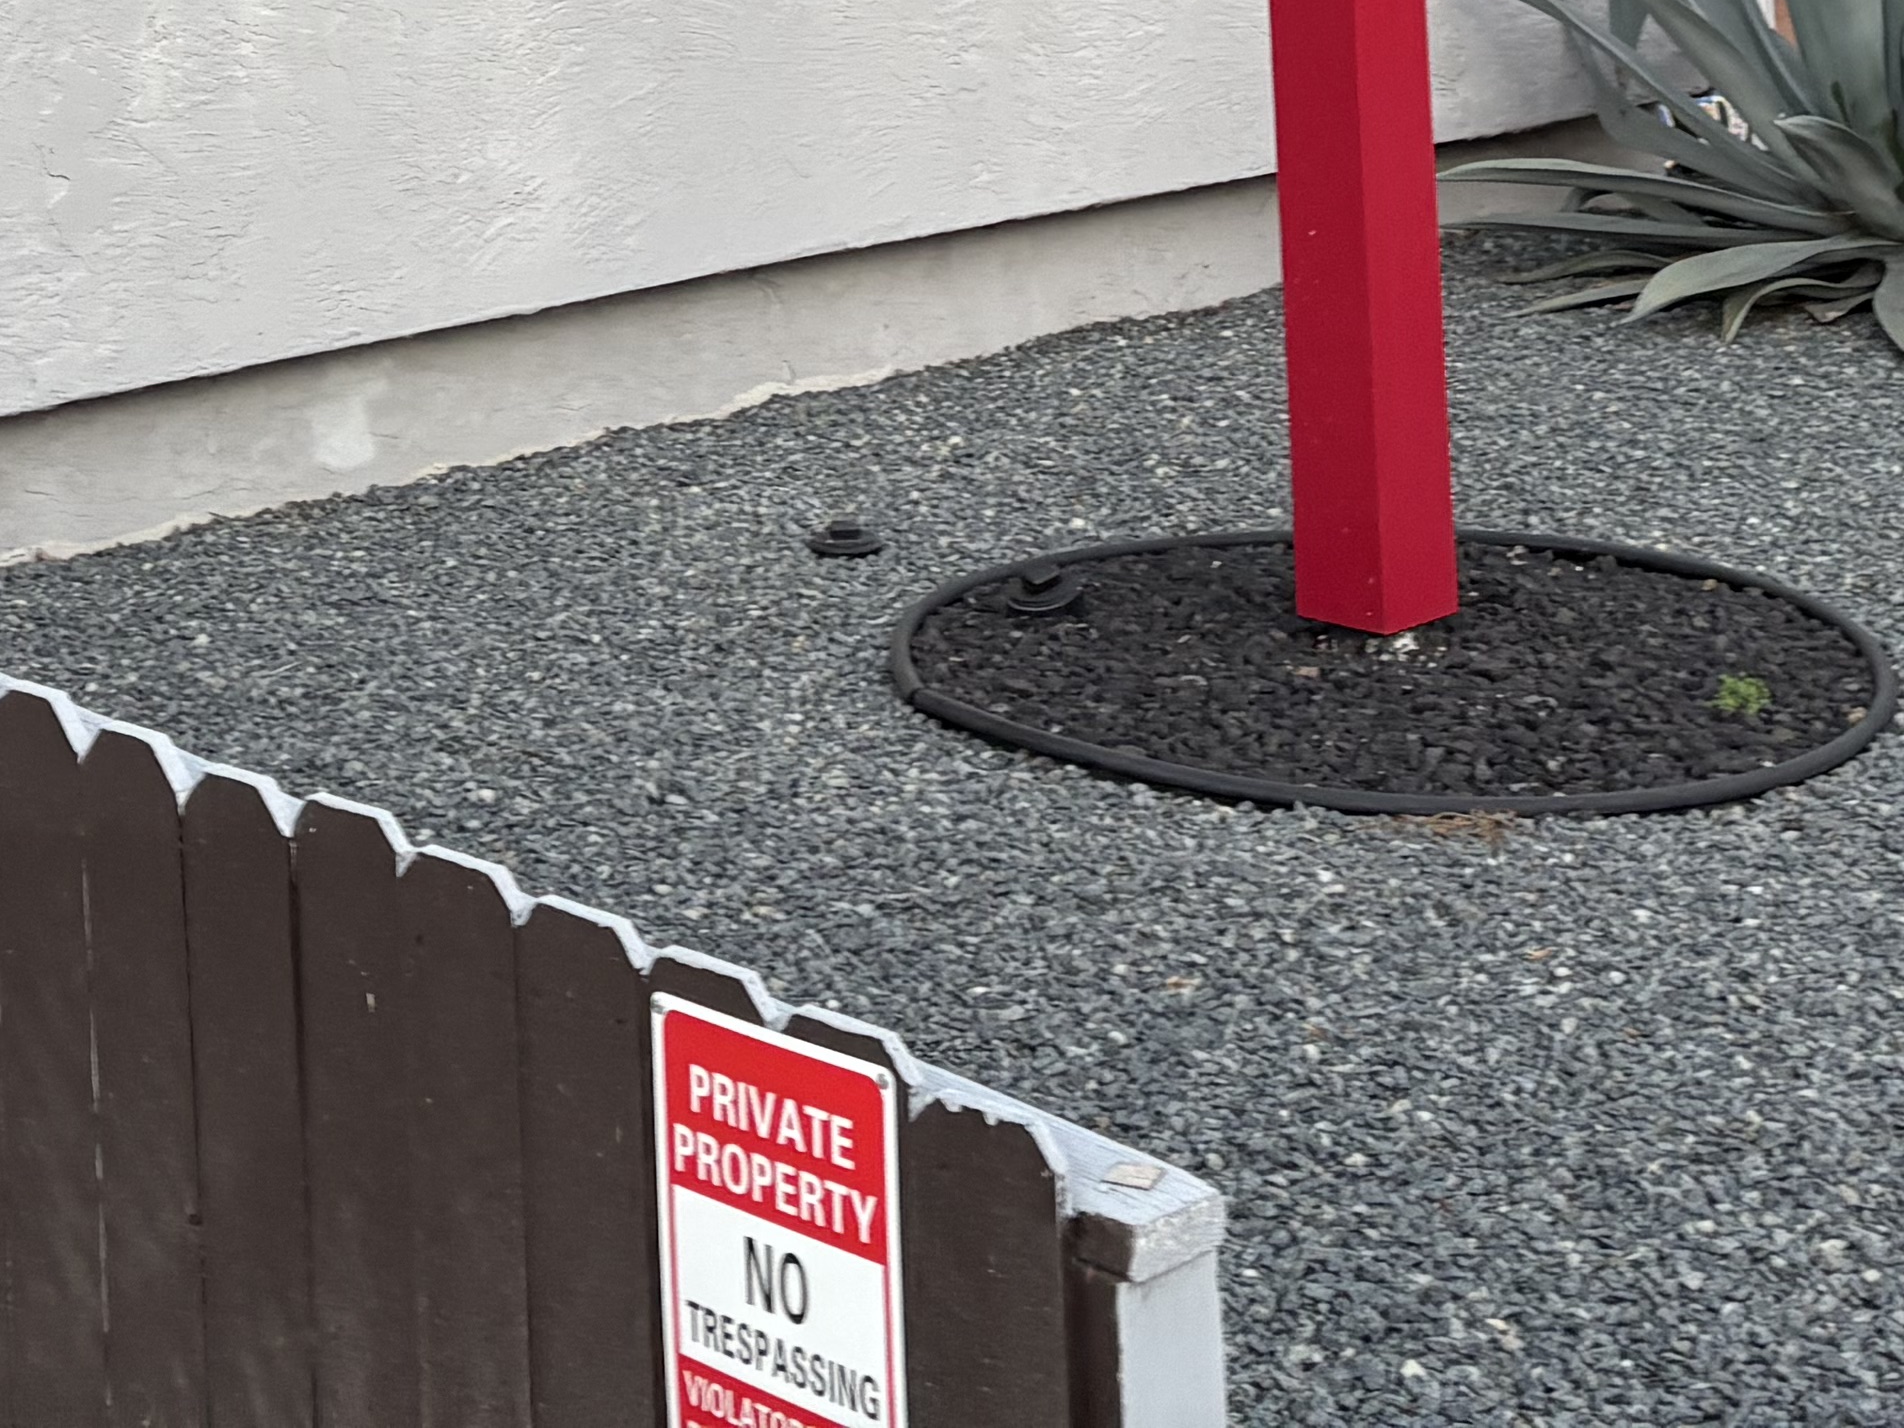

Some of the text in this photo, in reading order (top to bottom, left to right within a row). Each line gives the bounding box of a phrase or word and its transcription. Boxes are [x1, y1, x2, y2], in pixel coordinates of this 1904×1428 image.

[689, 1063, 856, 1170] PRIVATE
[672, 1122, 878, 1244] PROPERTY
[744, 1235, 811, 1325] NO
[682, 1369, 817, 1428] VIOLAT
[685, 1300, 881, 1421] TRESPASSING
